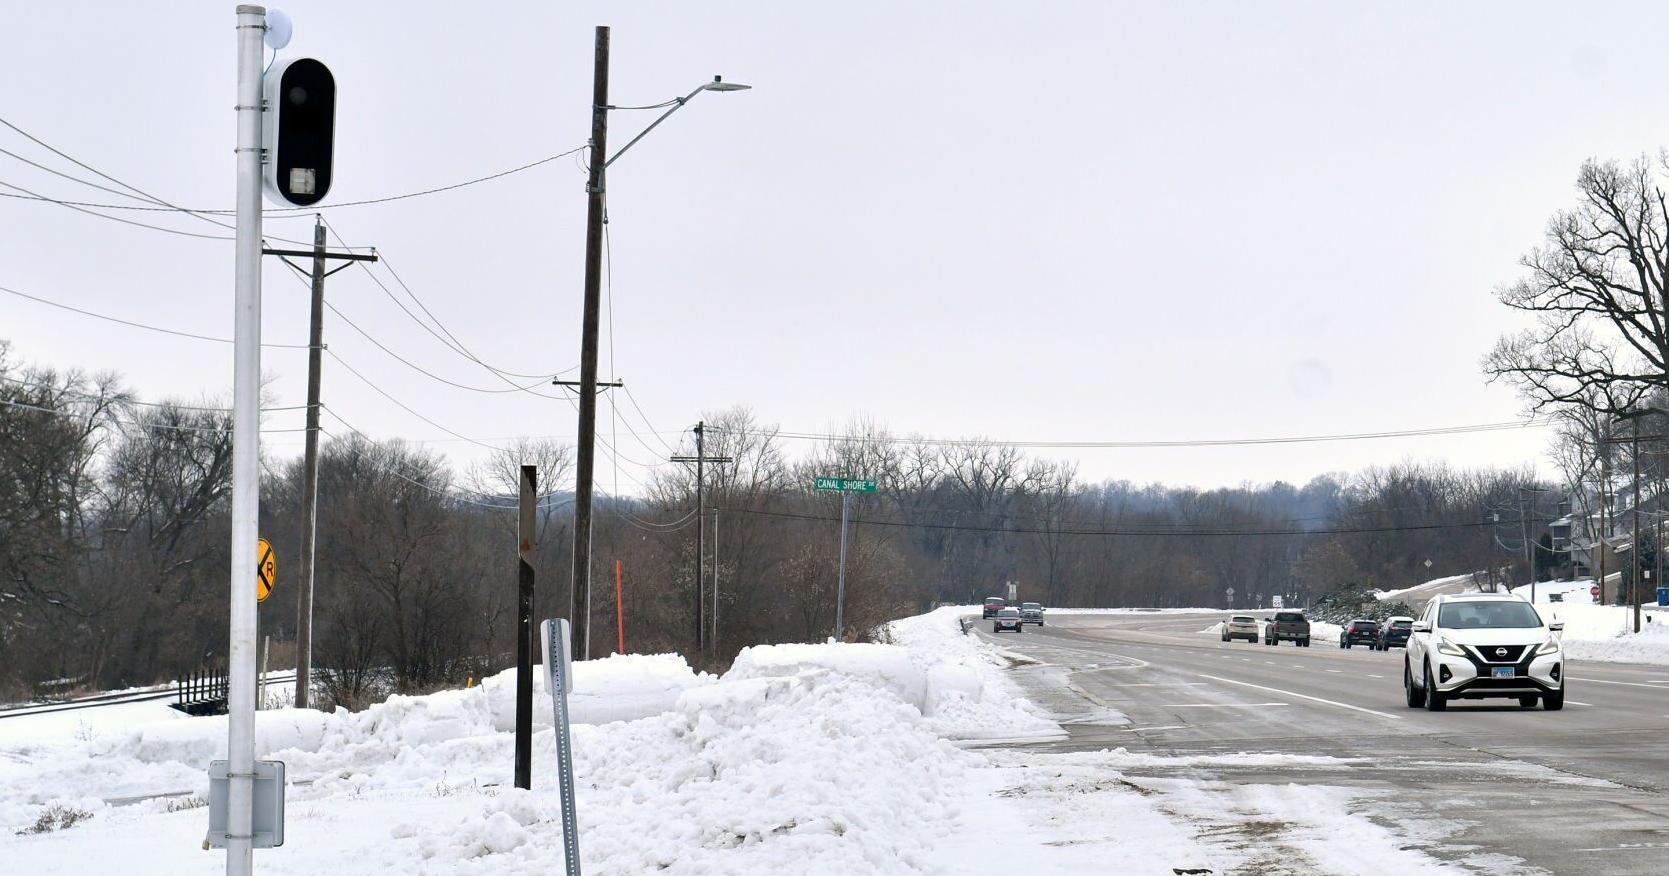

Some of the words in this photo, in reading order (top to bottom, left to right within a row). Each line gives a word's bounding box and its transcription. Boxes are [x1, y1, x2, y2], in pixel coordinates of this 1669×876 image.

[817, 479, 839, 488] CANAL
[843, 480, 866, 490] SHORE
[266, 561, 274, 577] R
